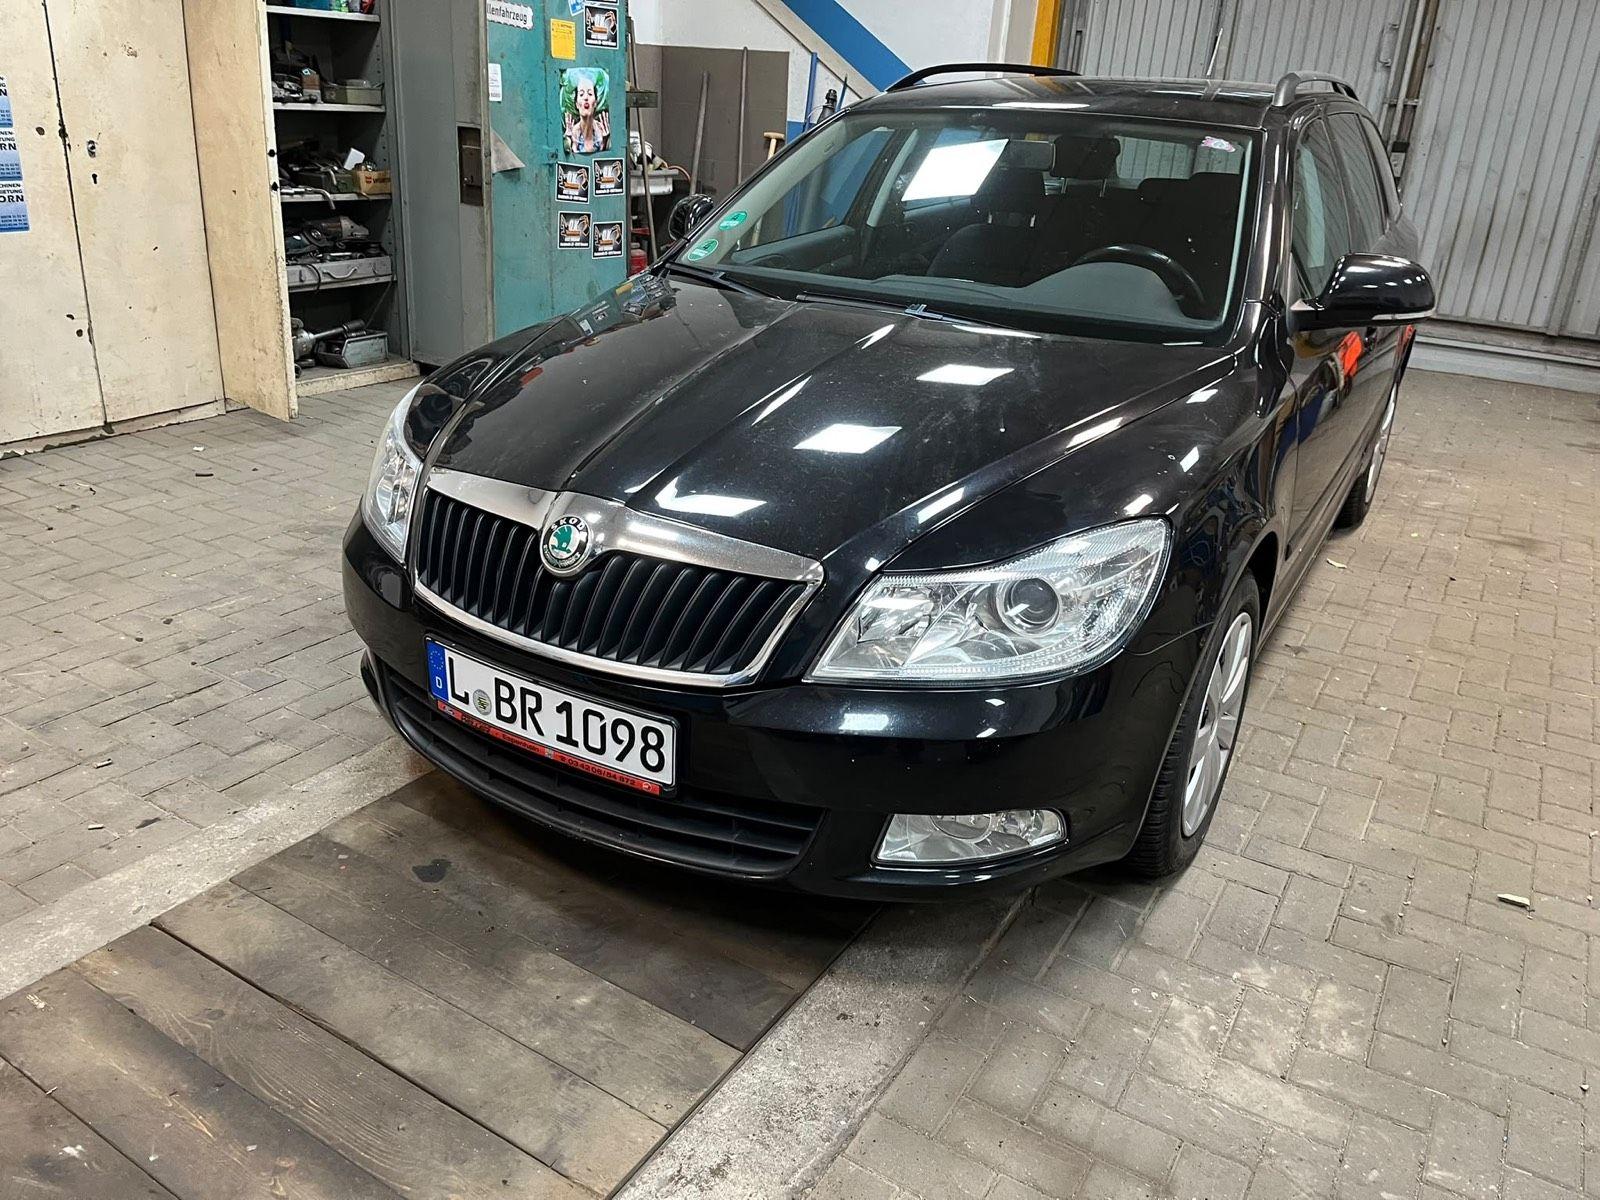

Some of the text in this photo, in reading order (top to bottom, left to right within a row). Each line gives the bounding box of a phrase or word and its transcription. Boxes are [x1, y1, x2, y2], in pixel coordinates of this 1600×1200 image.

[435, 675, 443, 689] D
[447, 656, 666, 773] L BR 1098
